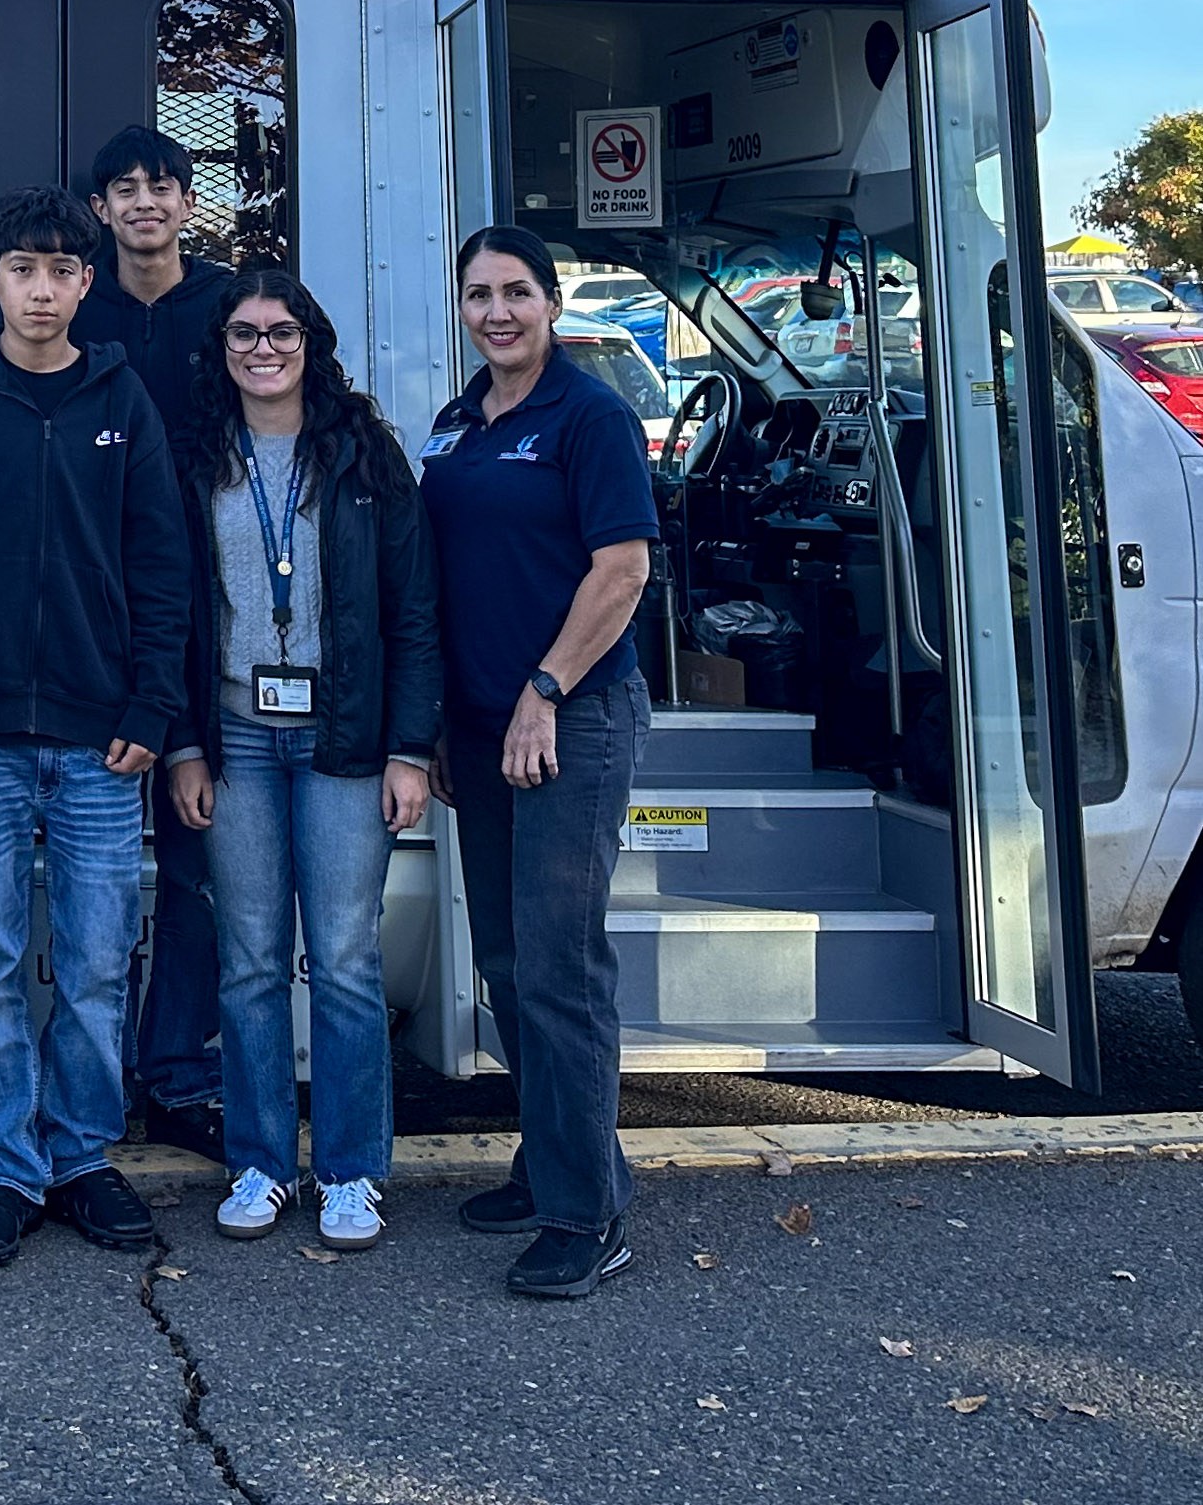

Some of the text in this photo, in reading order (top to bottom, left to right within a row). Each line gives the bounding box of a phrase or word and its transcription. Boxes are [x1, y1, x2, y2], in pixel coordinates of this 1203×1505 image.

[727, 132, 762, 163] 2009
[592, 188, 647, 200] NO FOOD
[590, 201, 649, 213] OR DRINK
[648, 809, 702, 820] CAUTION
[635, 827, 652, 836] Trip
